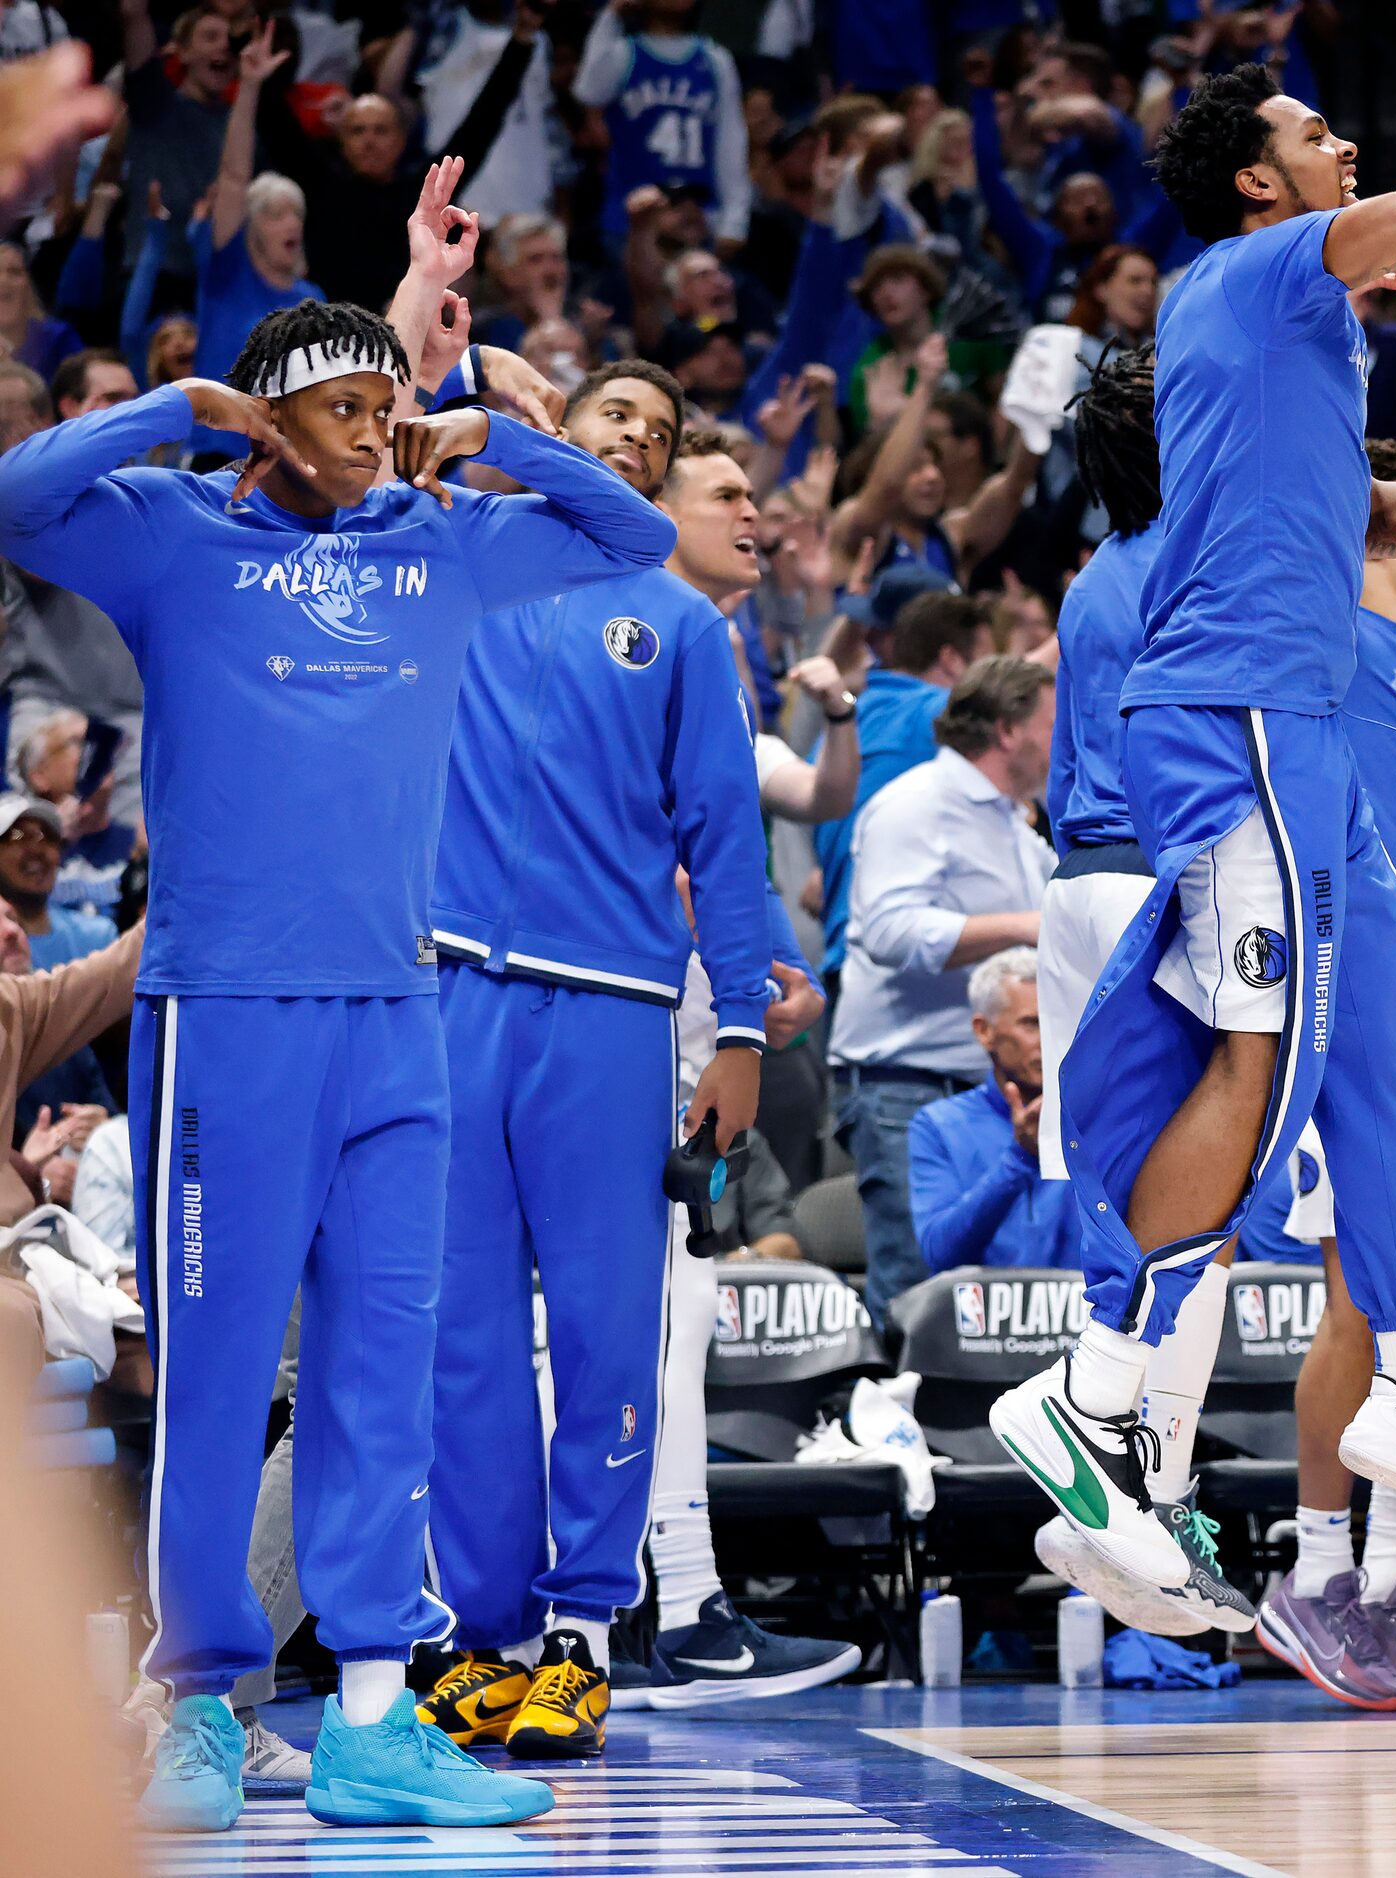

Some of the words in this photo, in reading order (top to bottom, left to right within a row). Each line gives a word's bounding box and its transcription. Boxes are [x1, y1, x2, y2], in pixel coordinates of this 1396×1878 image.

[646, 110, 704, 168] 41
[233, 559, 385, 604] DALLAS
[394, 556, 428, 598] IN
[305, 664, 342, 674] DALLAS
[343, 664, 389, 674] MAVERICKS
[1311, 868, 1333, 937] DALLAS
[1312, 941, 1334, 1053] MAVERICKS
[180, 1106, 200, 1179] DALLAS
[182, 1182, 204, 1298] MAVERICKS
